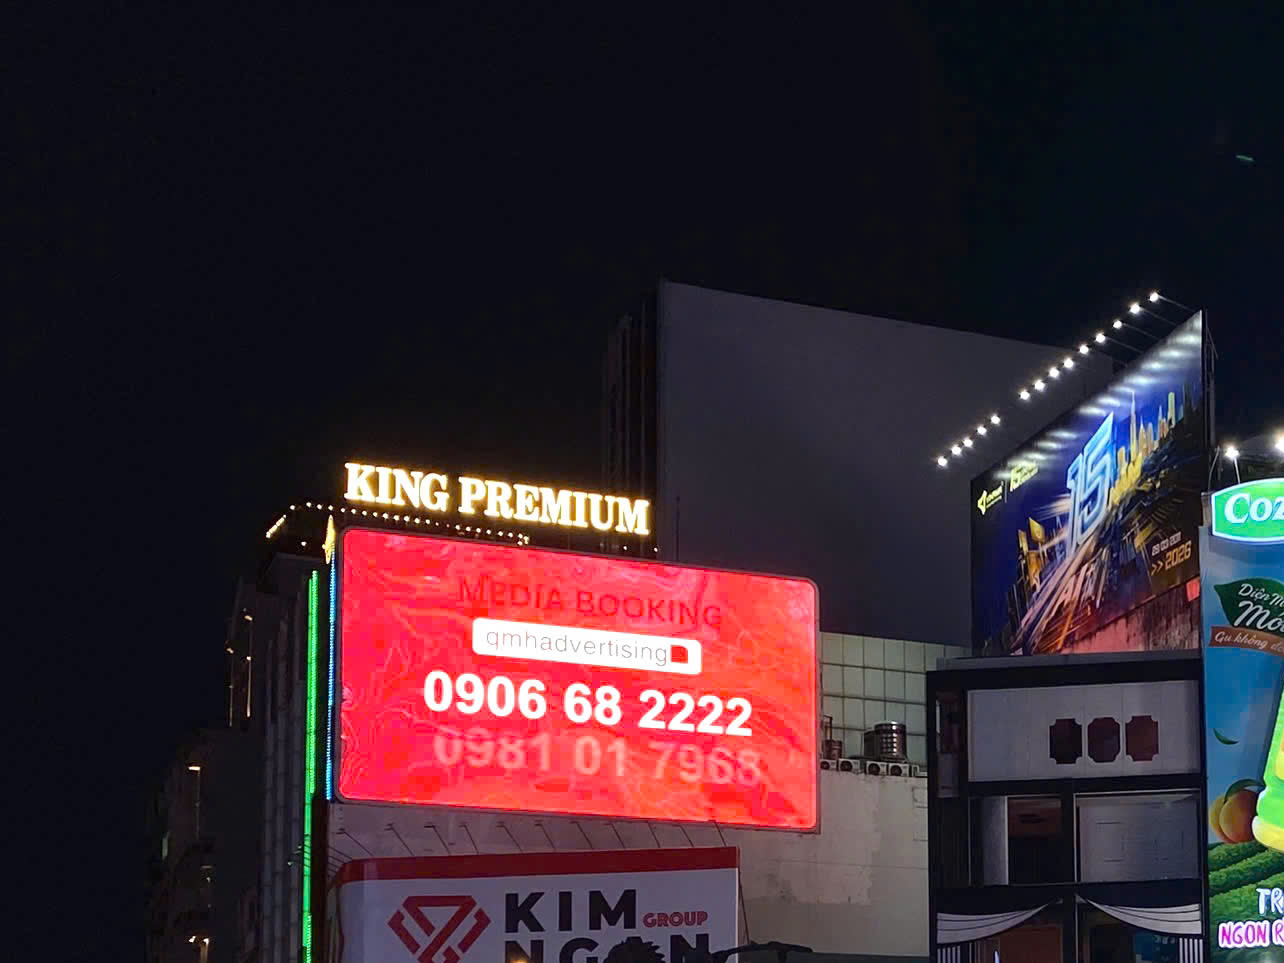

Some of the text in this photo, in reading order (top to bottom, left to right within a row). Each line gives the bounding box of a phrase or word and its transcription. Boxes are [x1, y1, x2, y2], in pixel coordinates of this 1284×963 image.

[344, 462, 650, 536] KING PREMIUM
[460, 577, 721, 627] MEDIA BOOKING
[1238, 583, 1270, 601] Diện
[1215, 631, 1232, 643] Gu
[1234, 631, 1268, 651] không
[424, 670, 753, 736] 0906 68 2222
[574, 735, 628, 777] 01
[504, 889, 708, 933] KIM GROUP
[1218, 920, 1271, 948] NGON
